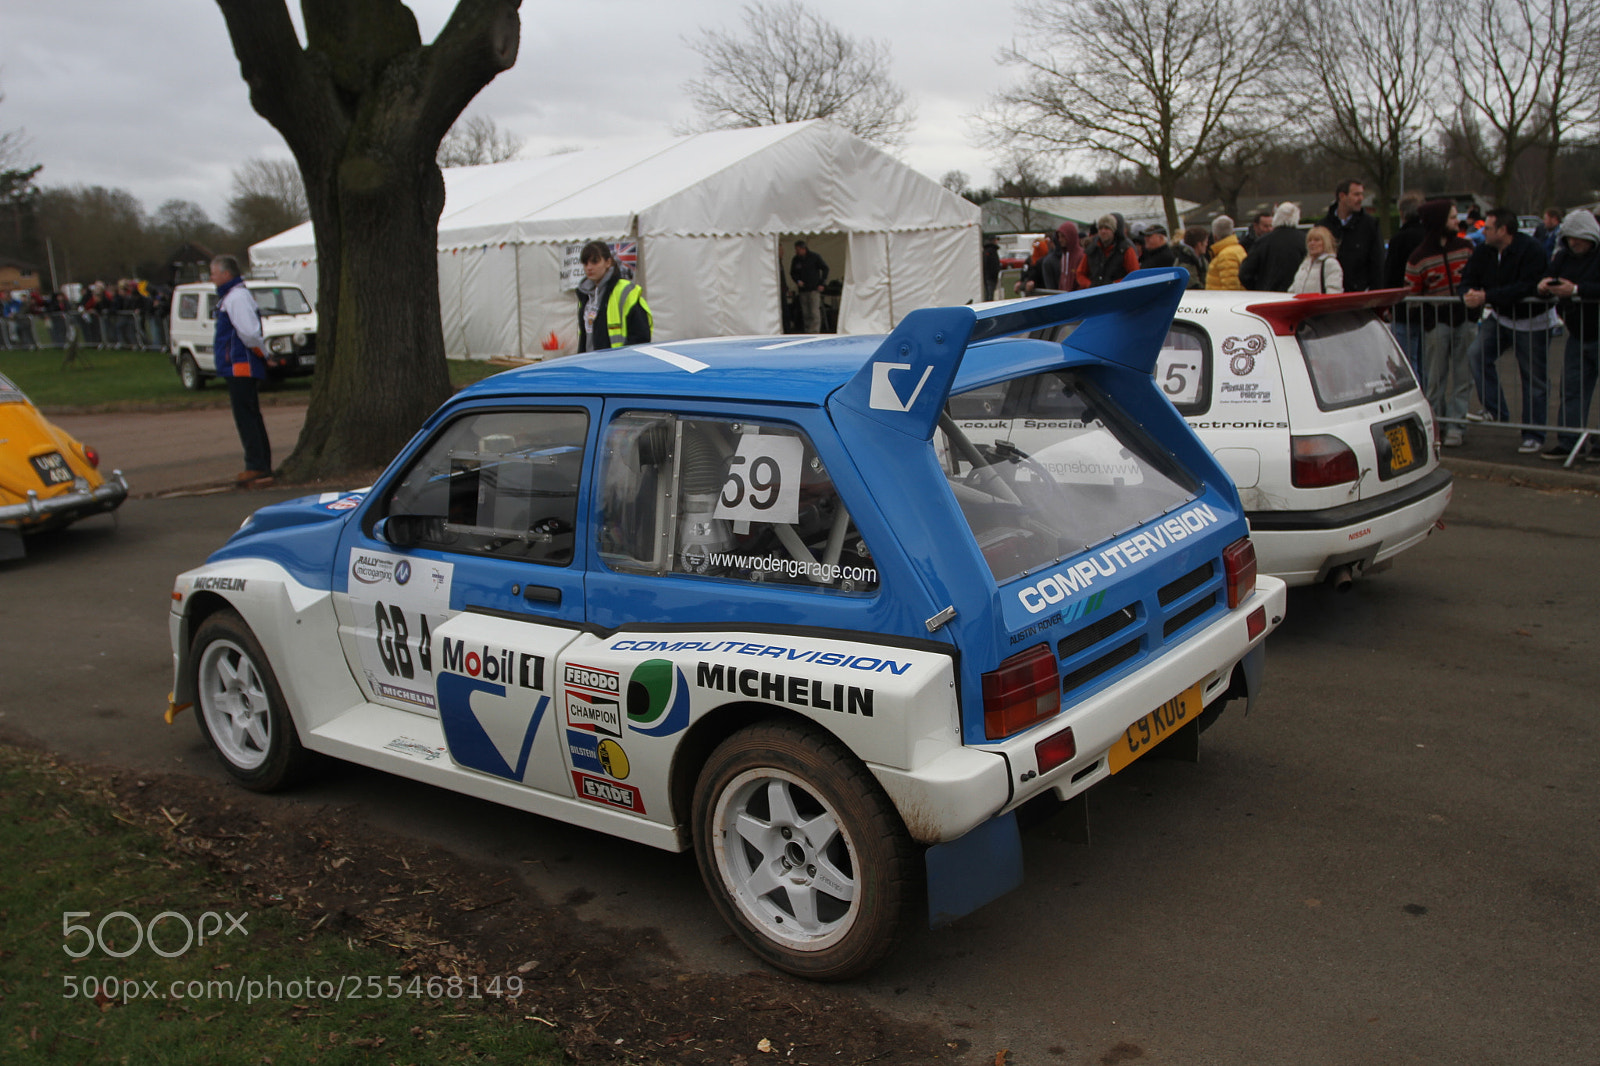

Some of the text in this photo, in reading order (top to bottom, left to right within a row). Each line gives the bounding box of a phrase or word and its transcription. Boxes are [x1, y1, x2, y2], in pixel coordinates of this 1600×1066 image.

[1154, 362, 1188, 395] 5
[720, 455, 782, 510] 59
[1348, 528, 1372, 541] NISSAN
[357, 556, 380, 567] RALLY
[709, 552, 877, 583] www.rodengarage.com
[1017, 503, 1218, 614] COMPUTERVISION
[193, 576, 248, 592] MICHELIN
[356, 567, 393, 583] microgaming
[375, 600, 414, 680] GB
[1009, 613, 1062, 646] AUSTIN ROVER
[442, 636, 515, 685] Mobil
[610, 640, 912, 675] COMPUTERVISION
[566, 668, 618, 691] FERODO
[696, 660, 875, 718] MICHELIN
[383, 686, 435, 706] MICHELIN
[570, 704, 617, 725] CHAMPION
[569, 745, 598, 760] BILSTEIN
[584, 780, 632, 805] EXIDE
